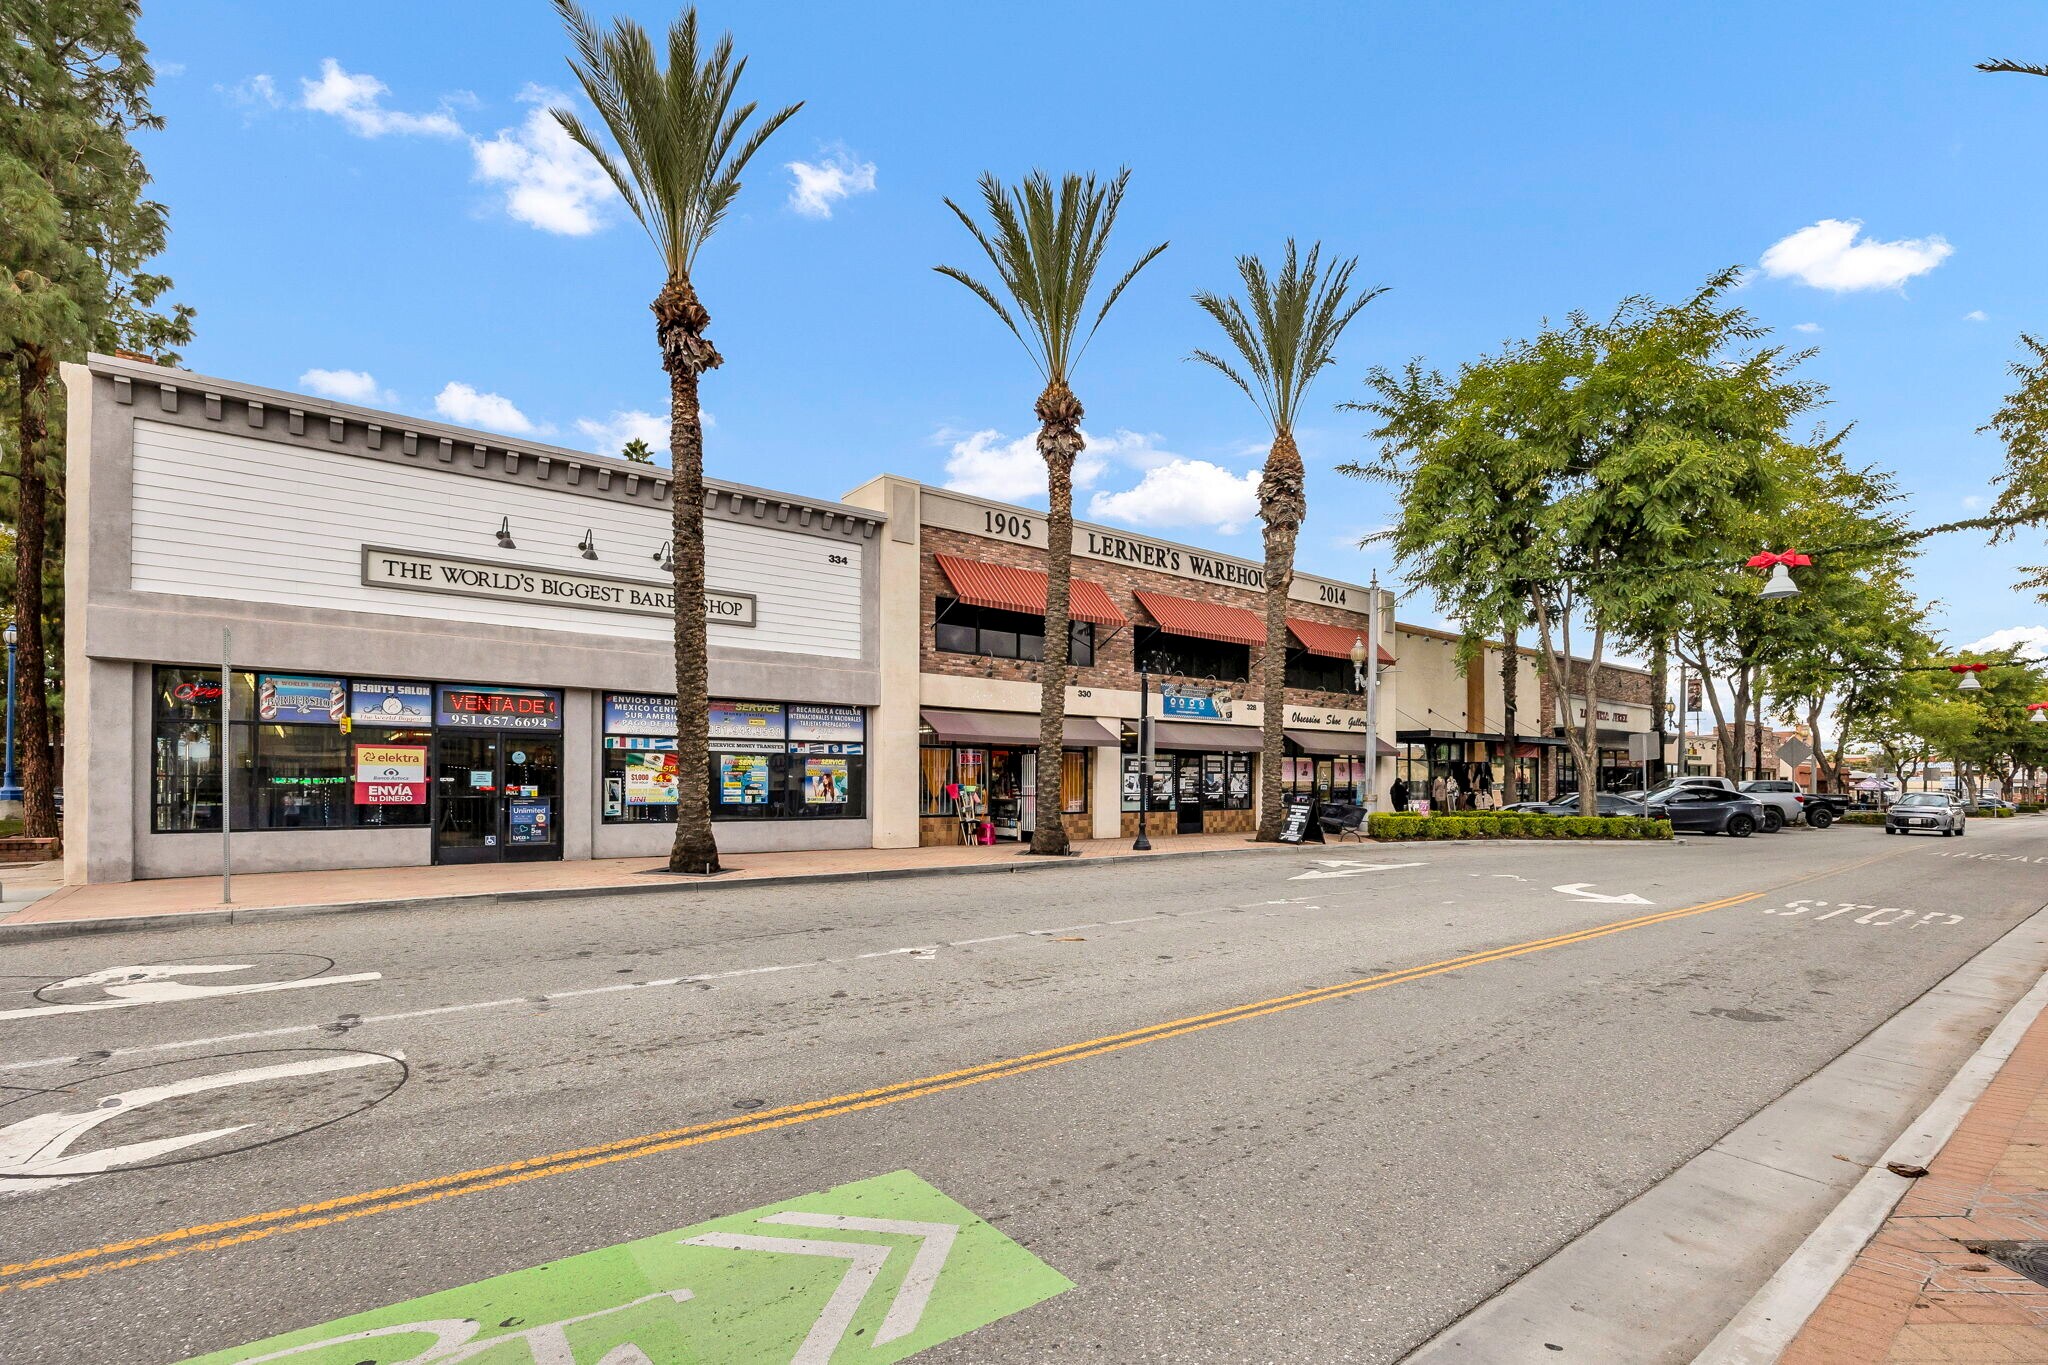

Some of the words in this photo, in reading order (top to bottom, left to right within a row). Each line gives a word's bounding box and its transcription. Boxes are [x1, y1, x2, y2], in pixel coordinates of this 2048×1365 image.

[985, 511, 1031, 539] 1905
[828, 554, 848, 565] 334
[1088, 533, 1180, 570] LERNER'S
[1189, 555, 1265, 589] WAREHOU
[383, 560, 432, 581] THE
[440, 566, 535, 593] WORLD'S
[541, 578, 624, 603] BIGGEST
[630, 590, 676, 609] BARB
[1319, 585, 1346, 605] 2014
[174, 683, 224, 700] Ope
[352, 683, 395, 694] BEAUTY
[397, 685, 430, 696] SALON
[1077, 690, 1092, 698] 330
[450, 694, 515, 713] VENTA
[519, 699, 545, 714] DE
[612, 695, 647, 704] ENVIOS
[614, 703, 650, 712] MEXICO
[652, 705, 677, 713] CENT
[796, 706, 828, 714] RECARGAS
[624, 711, 643, 719] SUR
[788, 713, 830, 721] INTERNACIONALES
[834, 715, 862, 723] NACIONALES
[1326, 715, 1341, 725] Shoe
[451, 714, 547, 728] 951.657.6694
[377, 753, 420, 763] elektra
[807, 758, 846, 766] SERVICE
[368, 784, 412, 796] ENVÍA
[1763, 900, 1964, 930] STOP
